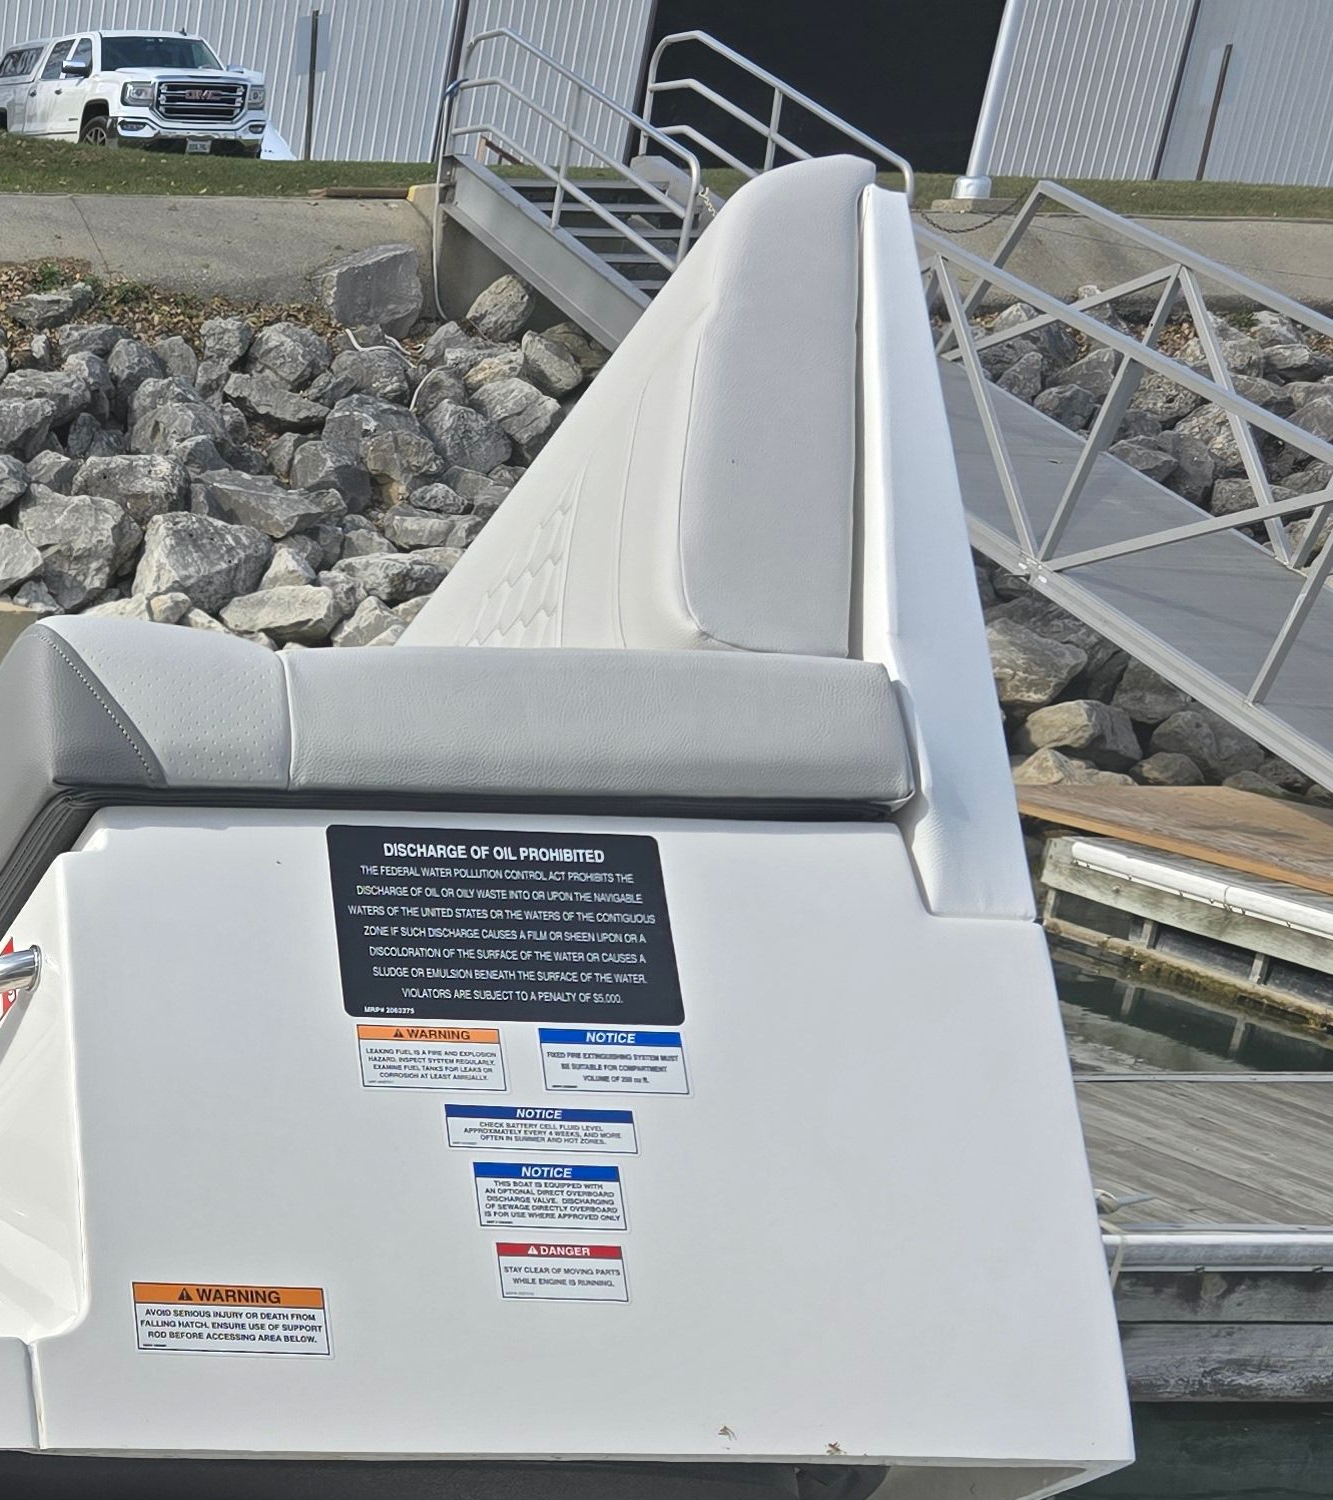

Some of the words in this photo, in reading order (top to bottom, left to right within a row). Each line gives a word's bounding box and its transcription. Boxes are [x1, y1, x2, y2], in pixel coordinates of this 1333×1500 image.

[383, 842, 467, 859] DISCHARGE
[470, 845, 489, 860] OF
[492, 846, 516, 860] OIL
[519, 847, 605, 863] PROHIBITED
[359, 865, 378, 875] THE
[379, 865, 419, 876] FEDERAL
[420, 867, 452, 877] WATER
[453, 868, 503, 879] POLLUTION
[504, 869, 546, 880] CONTROL
[548, 871, 565, 881] ACT
[567, 871, 614, 882] PROHIBITS
[615, 873, 633, 883] THE
[356, 885, 408, 896] DISCHARGE
[410, 886, 423, 896] OF
[424, 887, 439, 897] OIL
[440, 887, 454, 897] OR
[476, 888, 507, 899] WASTE
[508, 890, 530, 900] INTO
[531, 890, 545, 900] OR
[546, 891, 573, 901] UPON
[574, 892, 592, 902] THE
[593, 892, 642, 903] NAVIGABLE
[347, 905, 385, 915] WATERS
[386, 906, 399, 916] OF
[401, 906, 419, 916] THE
[420, 907, 453, 917] UNITED
[455, 908, 488, 918] STATES
[489, 909, 503, 919] OR
[505, 910, 523, 920] THE
[524, 910, 560, 921] WATERS
[562, 911, 575, 921] OF
[576, 912, 594, 922] THE
[363, 925, 389, 936] ZONE
[390, 926, 399, 936] IF
[400, 926, 426, 937] SUCH
[427, 927, 480, 939] DISCHARGE
[481, 929, 517, 940] CAUSES
[527, 930, 548, 941] FILM
[548, 931, 563, 941] OR
[563, 931, 595, 942] SHEEN
[596, 932, 623, 943] UPON
[623, 933, 638, 944] OR
[369, 945, 441, 957] DISCOLORATION
[442, 947, 455, 958] OF
[457, 948, 475, 958] THE
[476, 948, 518, 960] SURFACE
[519, 950, 532, 960] OF
[534, 950, 552, 961] THE
[553, 951, 585, 962] WATER
[585, 952, 600, 962] OR
[601, 952, 637, 963] CAUSES
[372, 966, 409, 977] SLUDGE
[410, 967, 424, 977] OR
[425, 967, 473, 979] EMULSION
[474, 969, 516, 980] BENEATH
[517, 970, 535, 981] THE
[536, 971, 578, 982] SURFACE
[579, 972, 593, 982] OF
[594, 972, 613, 983] THE
[401, 987, 451, 998] VIOLATORS
[453, 988, 471, 999] ARE
[473, 989, 513, 1000] SUBJECT
[515, 990, 528, 1000] TO
[537, 991, 576, 1002] PENALTY
[578, 992, 591, 1002] OF
[407, 1029, 470, 1039] WARNING
[584, 1032, 637, 1043] NOTICE
[515, 1109, 563, 1119] NOTICE
[520, 1166, 573, 1178] NOTICE
[539, 1246, 590, 1256] DANGER
[196, 1288, 280, 1303] WARNING
[144, 1308, 171, 1316] AVOID
[173, 1309, 211, 1317] SERIOUS
[260, 1312, 289, 1320] DEATH
[290, 1313, 315, 1321] FROM
[211, 1322, 246, 1330] ENSURE
[281, 1324, 322, 1332] SUPPORT
